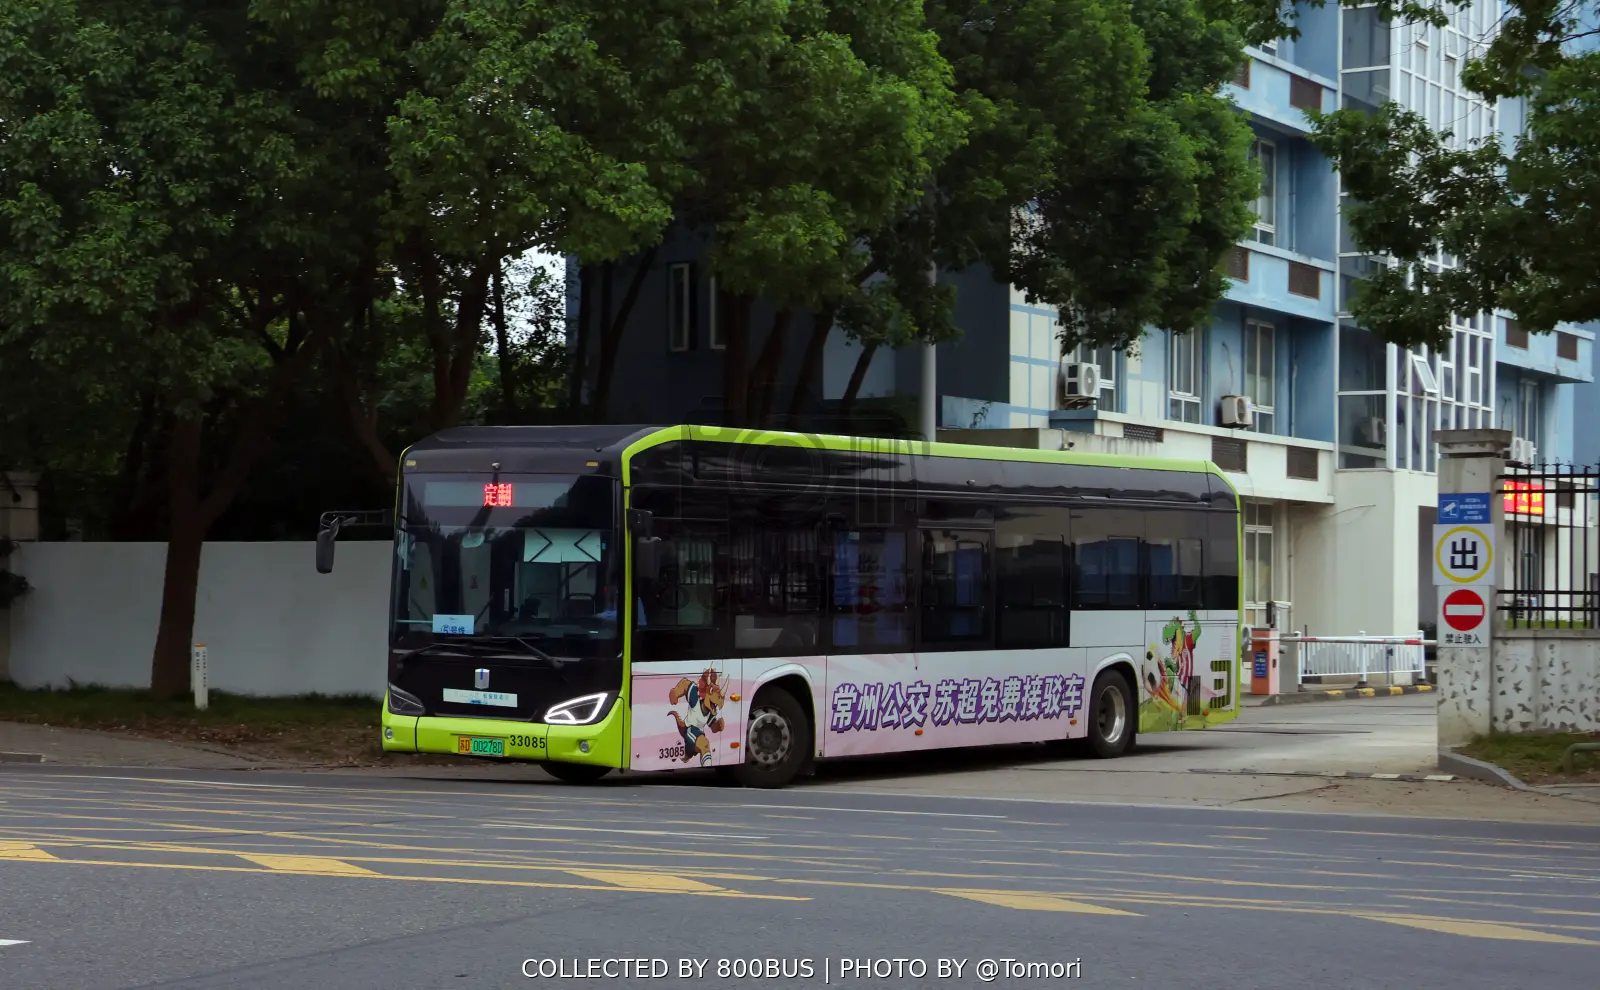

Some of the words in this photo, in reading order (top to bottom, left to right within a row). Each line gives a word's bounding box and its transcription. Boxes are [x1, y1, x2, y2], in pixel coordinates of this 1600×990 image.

[483, 483, 512, 507] 定制
[1450, 537, 1478, 570] 出
[1444, 633, 1482, 645] 禁止驶入
[831, 681, 931, 733] 常州公交
[931, 673, 1086, 727] 苏超免费接驳车
[509, 734, 546, 749] 33085
[658, 745, 685, 759] 33085
